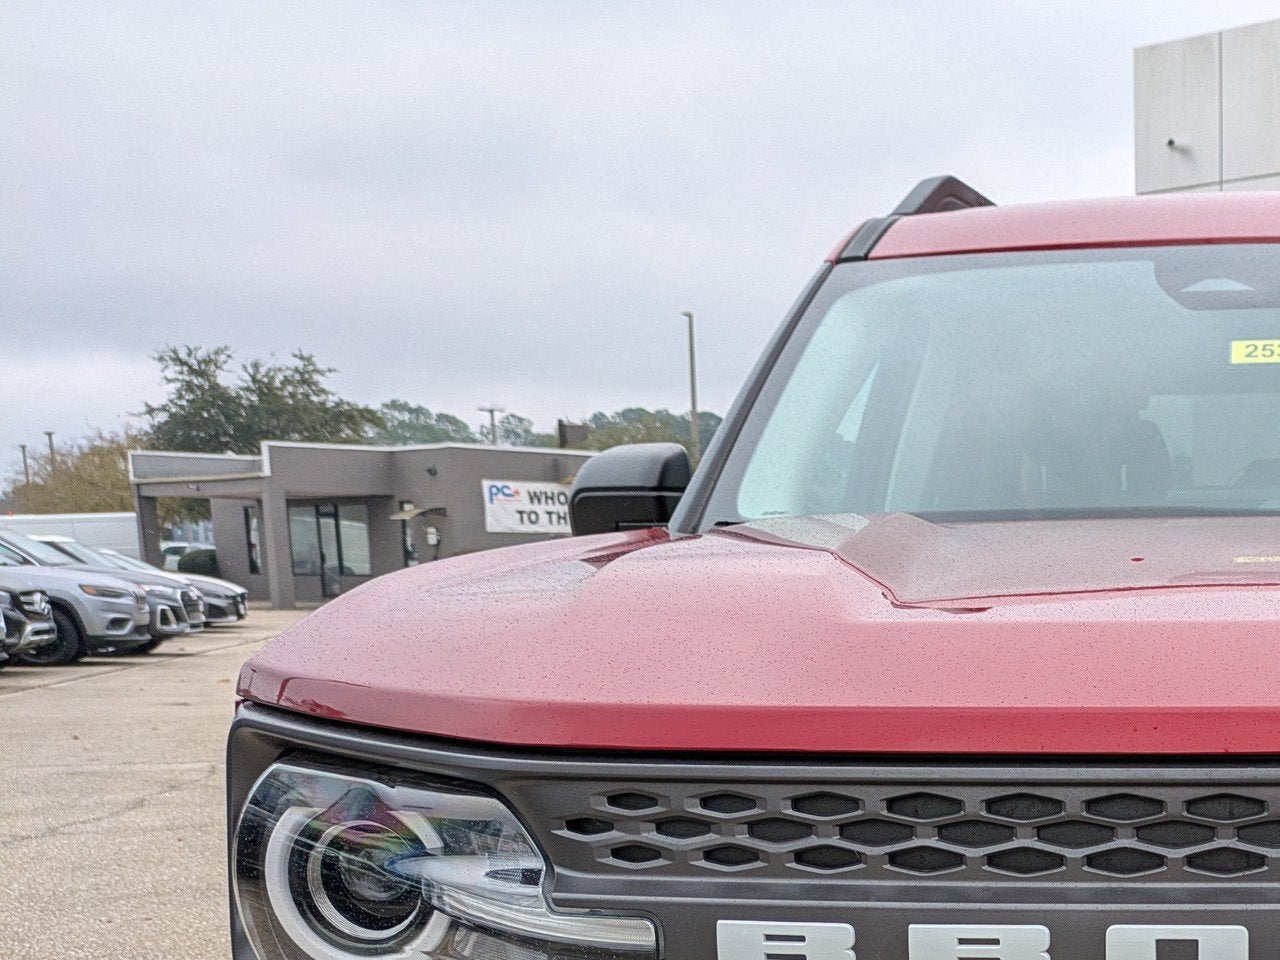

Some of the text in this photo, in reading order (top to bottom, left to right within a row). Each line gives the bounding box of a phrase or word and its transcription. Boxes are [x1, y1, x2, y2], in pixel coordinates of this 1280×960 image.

[527, 490, 569, 506] WHO
[516, 510, 568, 526] TO TH
